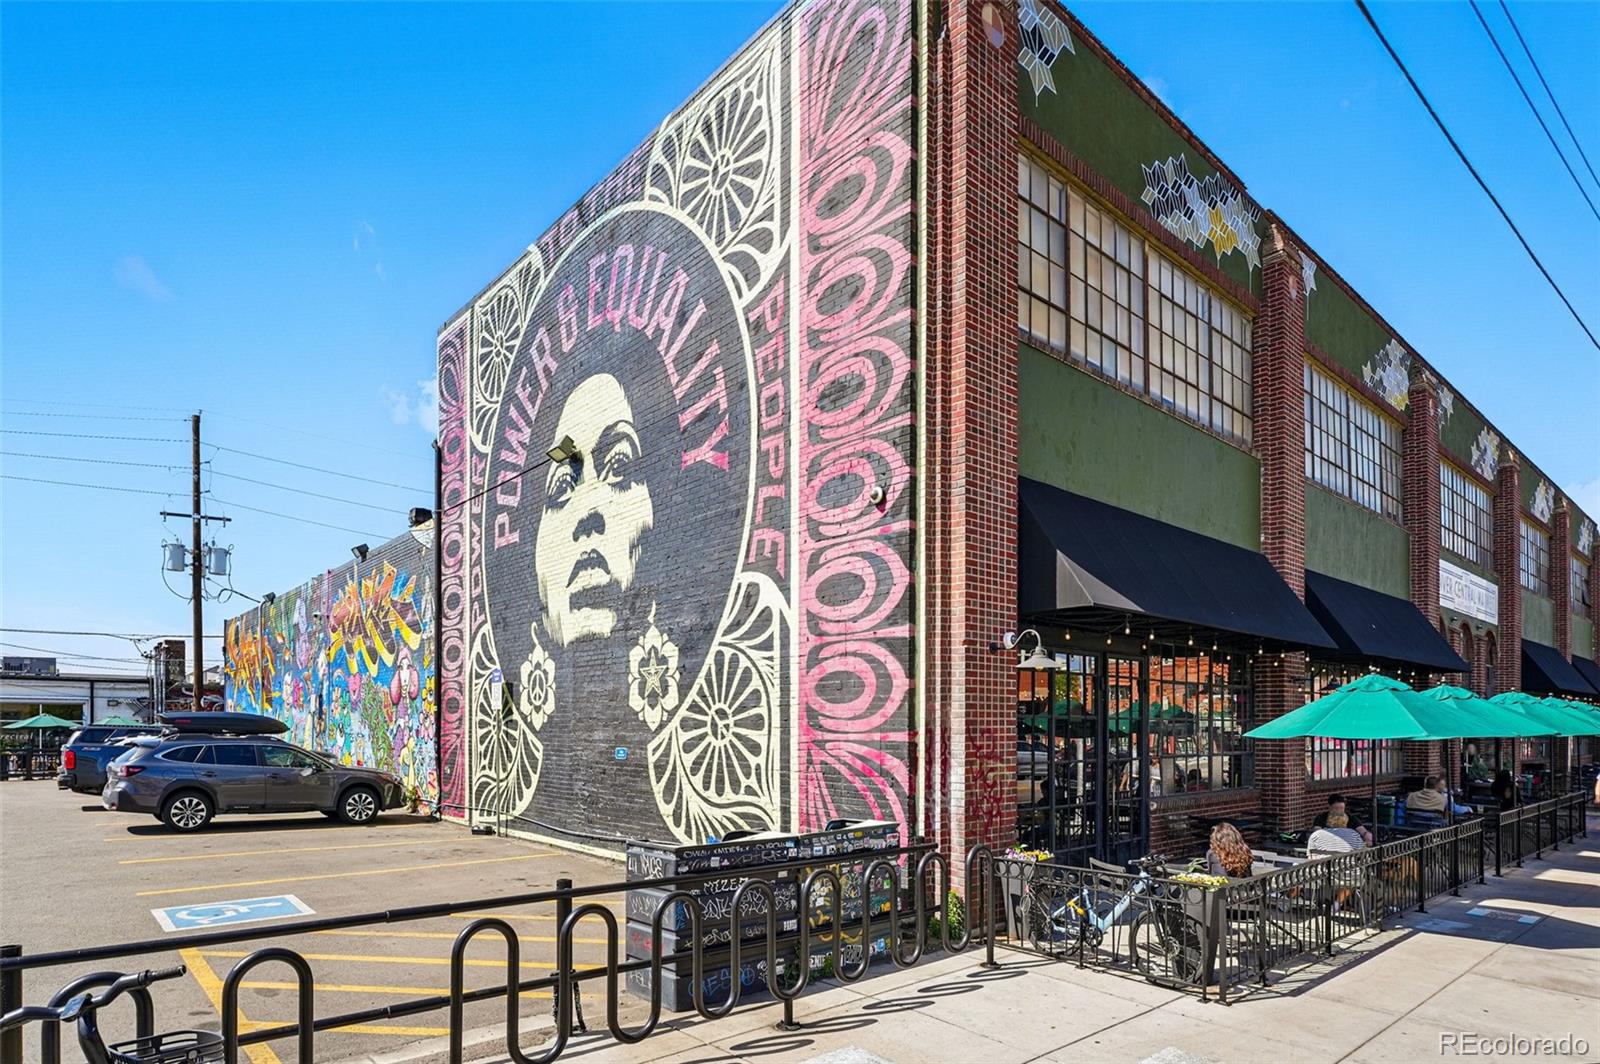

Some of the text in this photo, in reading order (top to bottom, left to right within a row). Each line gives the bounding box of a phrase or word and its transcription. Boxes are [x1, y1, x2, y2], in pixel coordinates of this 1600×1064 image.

[538, 140, 652, 264] TO THE
[494, 327, 558, 550] POWER
[585, 243, 730, 472] EQUALITY
[748, 272, 785, 580] PEOPLE
[471, 453, 487, 634] POWER
